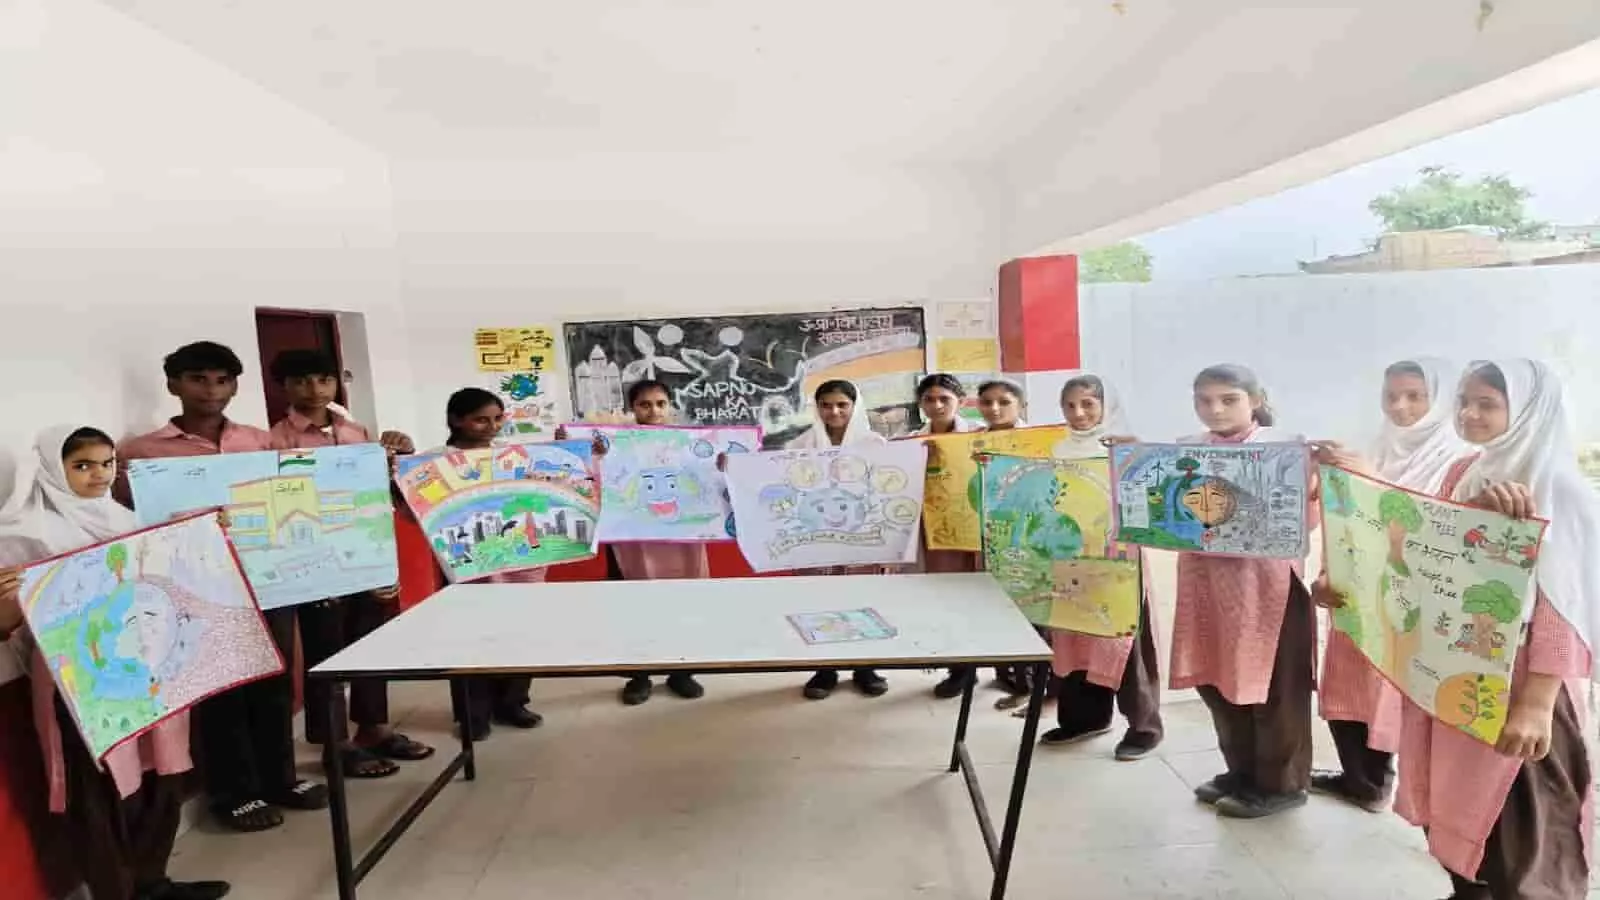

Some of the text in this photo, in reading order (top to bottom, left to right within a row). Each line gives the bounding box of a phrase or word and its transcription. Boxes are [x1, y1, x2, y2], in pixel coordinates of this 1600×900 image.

[688, 382, 756, 398] SAPNO
[725, 395, 748, 408] KA
[694, 406, 762, 420] BHARAT
